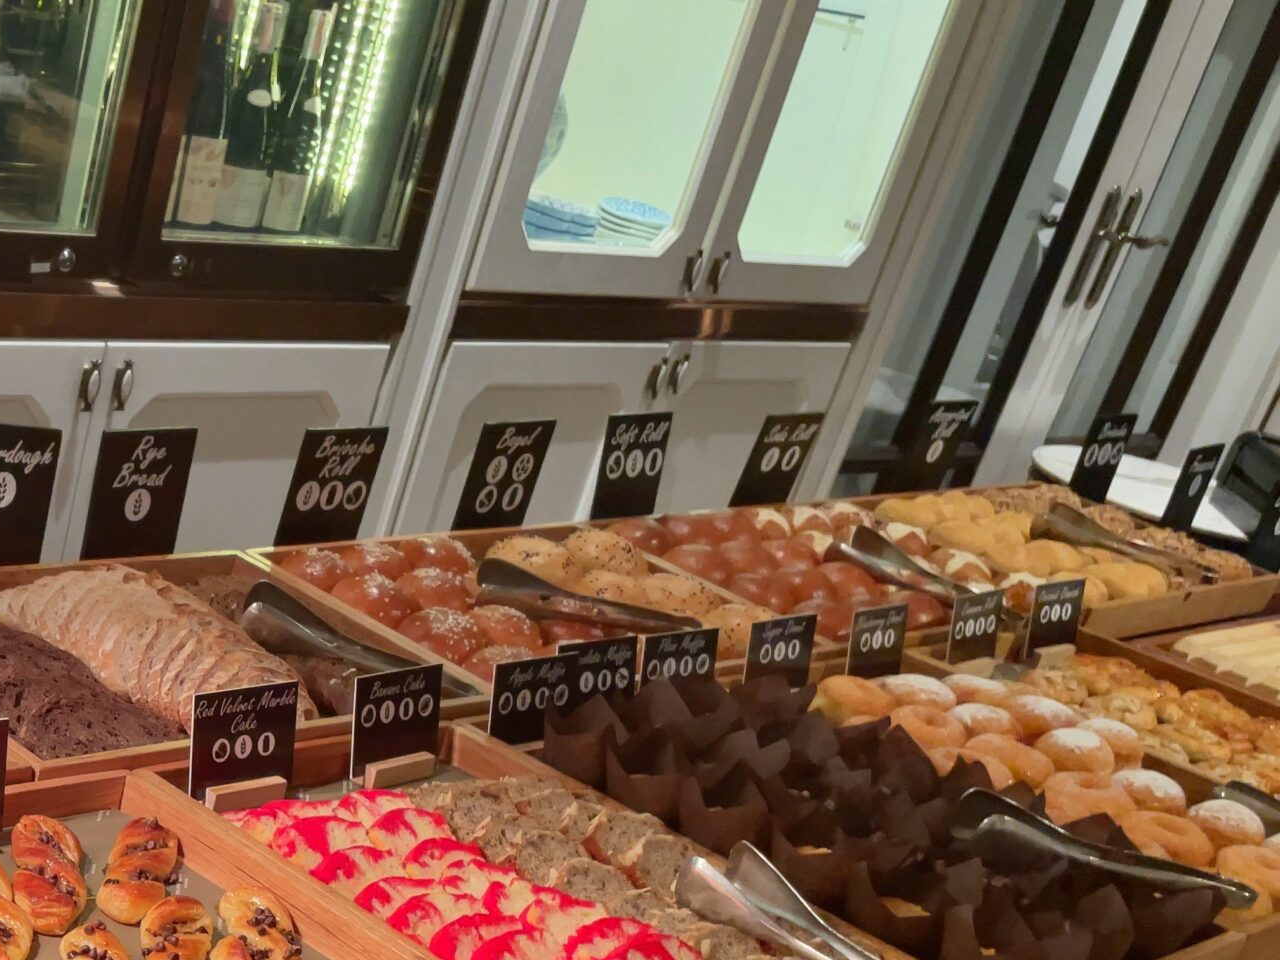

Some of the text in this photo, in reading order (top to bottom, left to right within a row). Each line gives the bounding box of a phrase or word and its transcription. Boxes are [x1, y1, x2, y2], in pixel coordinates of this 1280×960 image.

[496, 426, 544, 452] Bagel
[639, 421, 670, 444] Roll
[132, 435, 167, 468] Rye
[113, 463, 171, 489] Bread
[319, 455, 362, 479] Roll
[369, 674, 427, 700] Banana Cake
[194, 688, 297, 720] Red Velvet Marble
[230, 713, 258, 734] Cake
